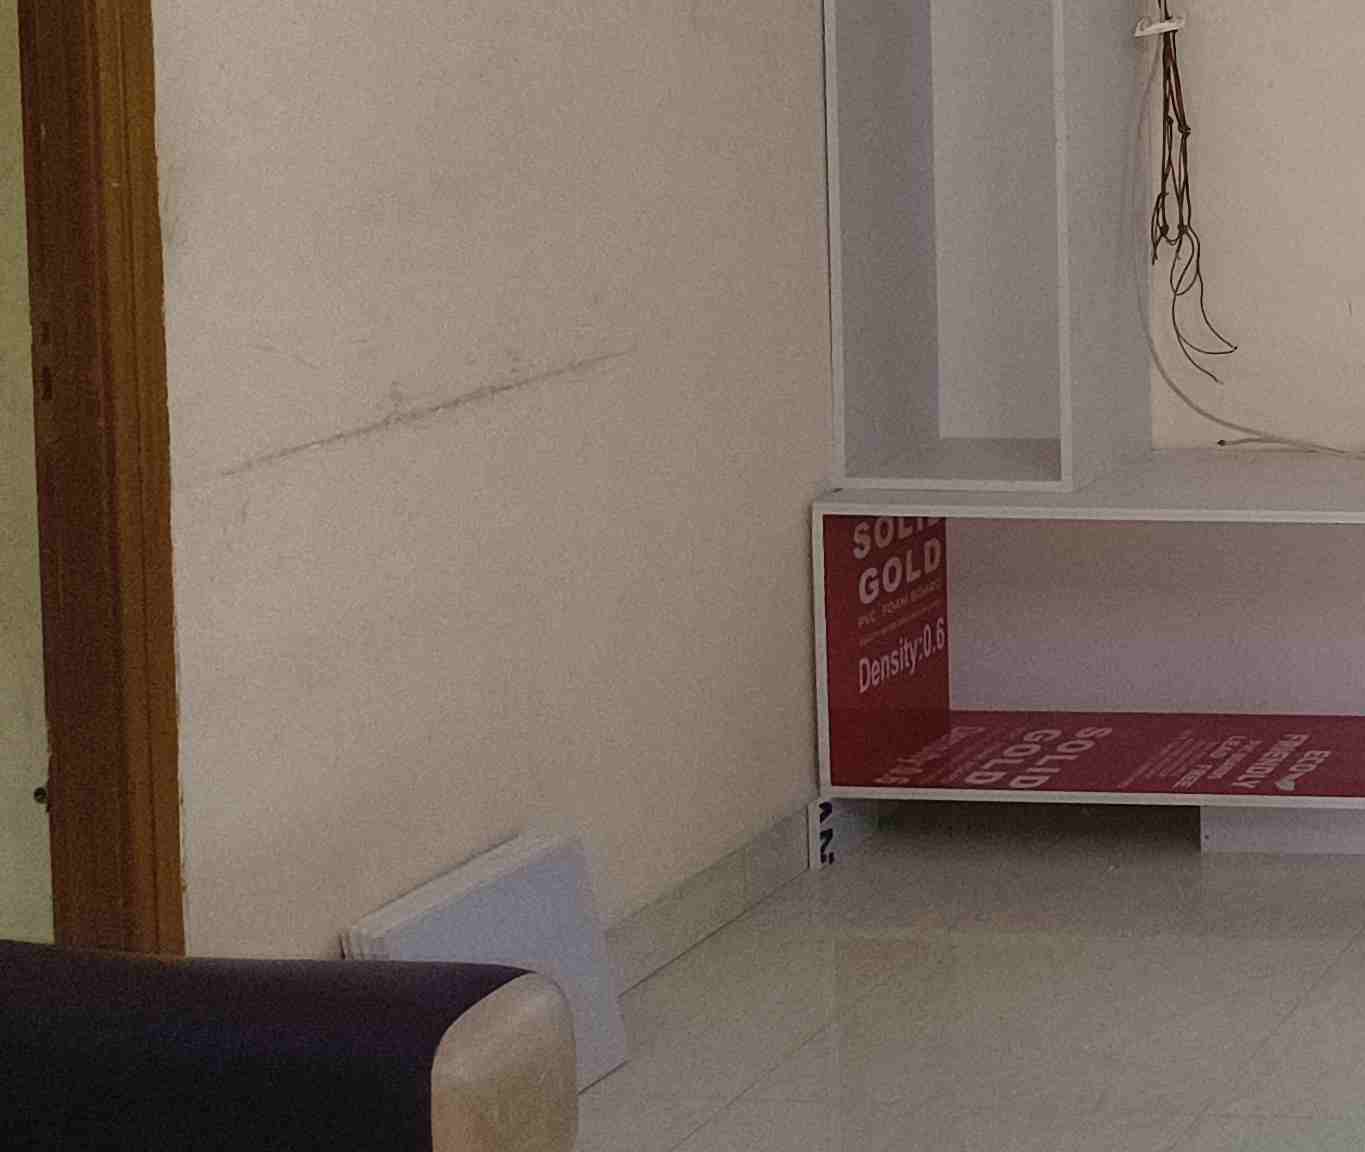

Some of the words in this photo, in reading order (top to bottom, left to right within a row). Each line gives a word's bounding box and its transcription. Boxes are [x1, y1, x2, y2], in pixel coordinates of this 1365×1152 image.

[853, 517, 938, 560] SOL
[858, 537, 942, 605] GOLD
[859, 617, 945, 694] Density:0.6
[964, 728, 1063, 785] GOLD
[1008, 726, 1113, 789] SOLID
